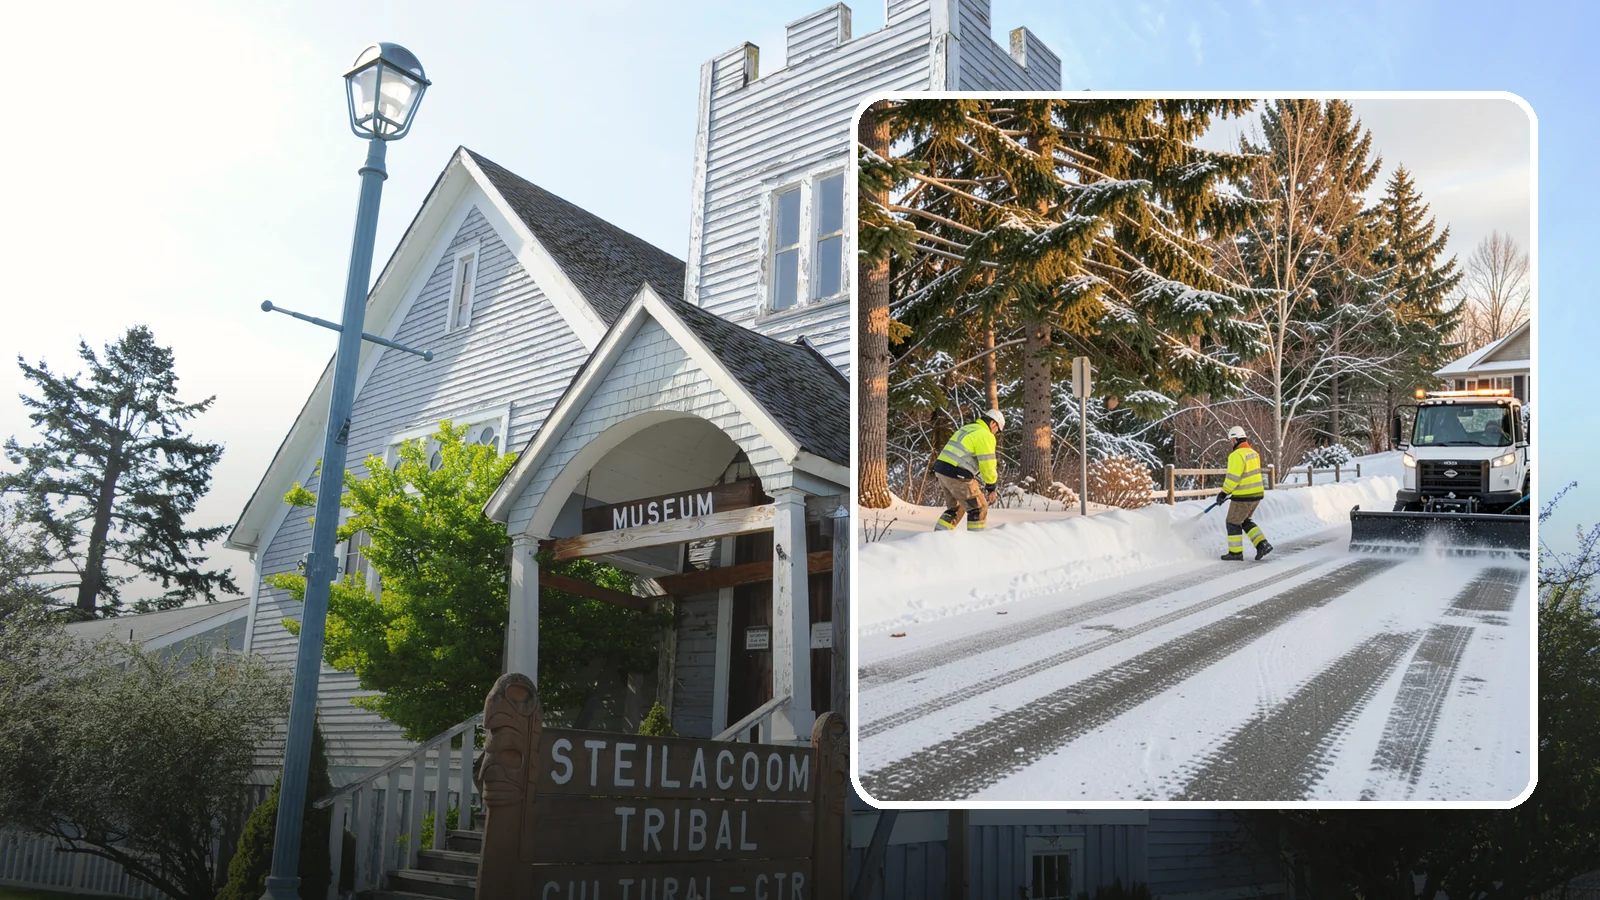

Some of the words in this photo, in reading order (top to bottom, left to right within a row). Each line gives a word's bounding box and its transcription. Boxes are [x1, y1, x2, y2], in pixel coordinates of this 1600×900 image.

[612, 491, 714, 531] MUSEUM
[550, 738, 810, 793] STEILACOOM
[614, 806, 758, 852] TRIBAL
